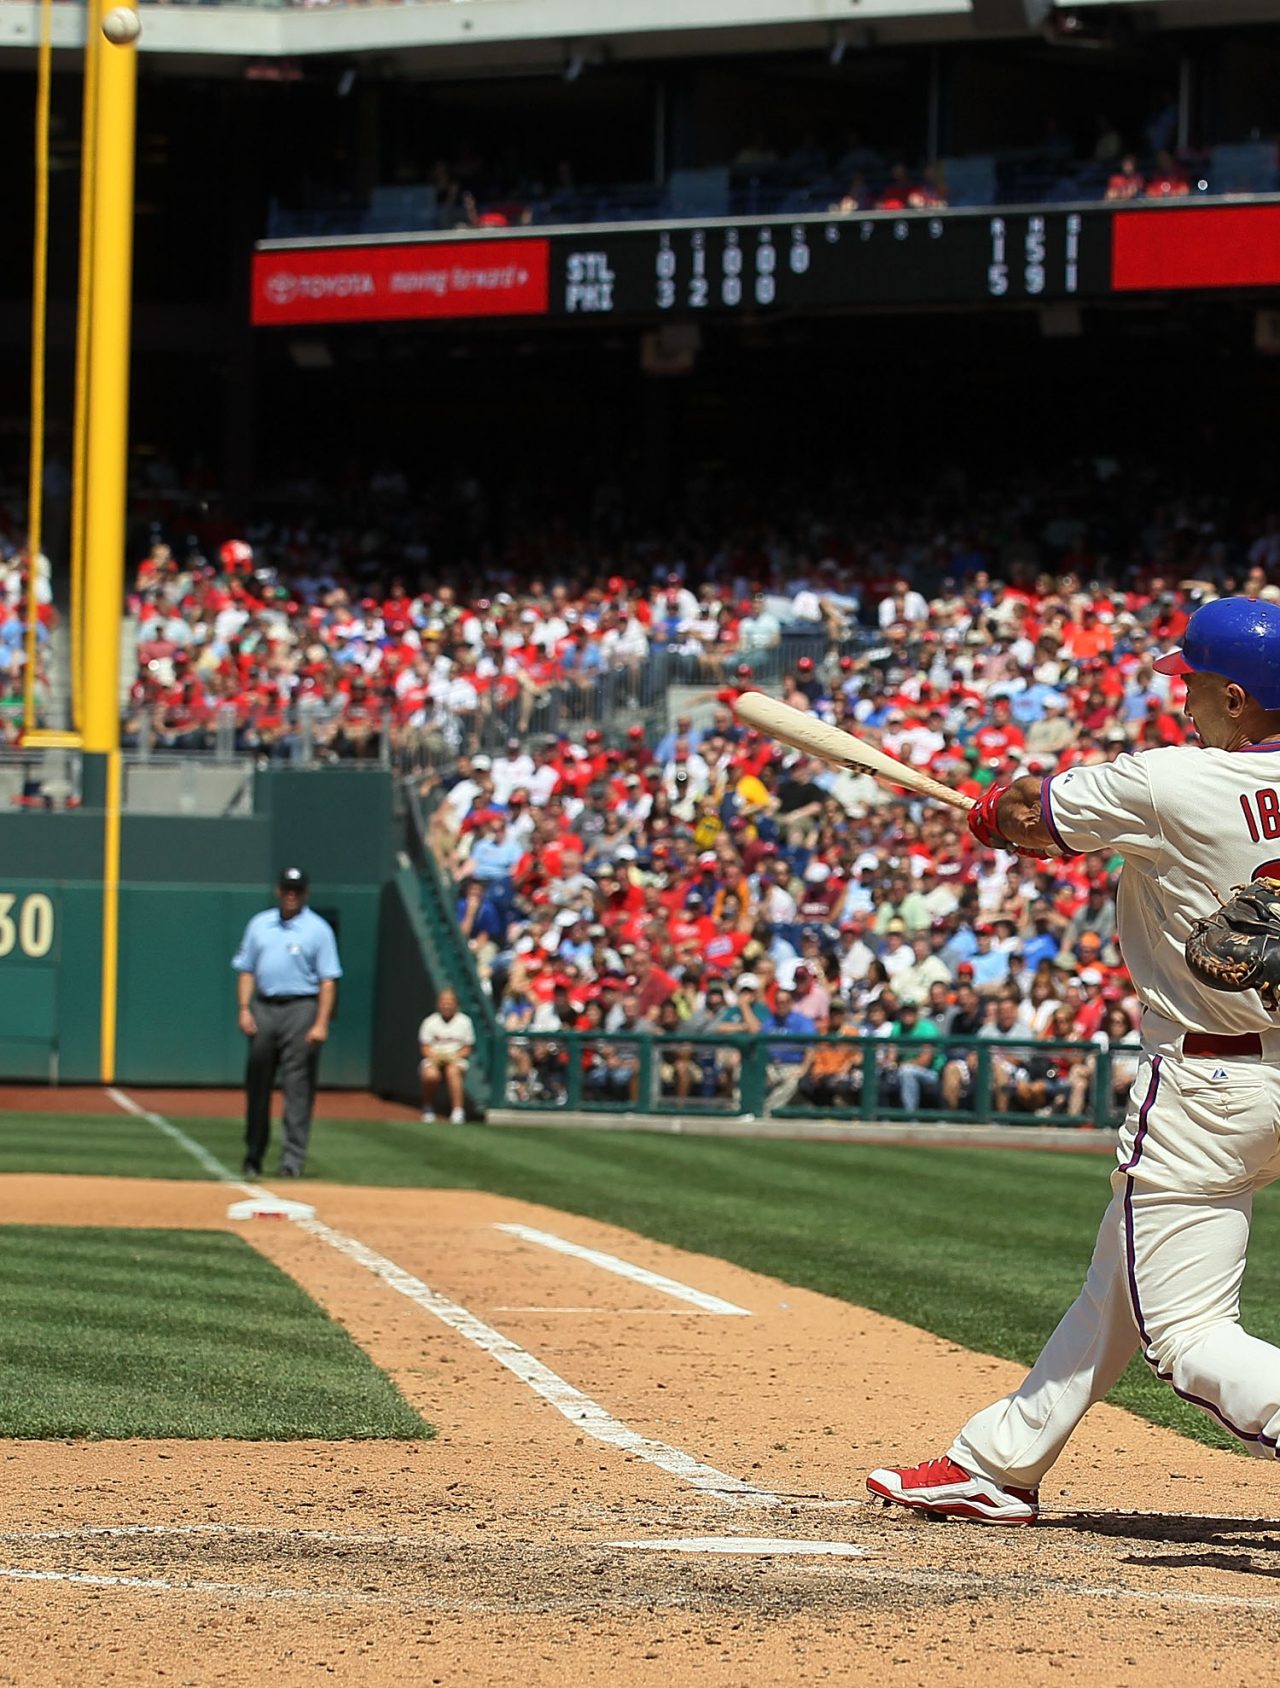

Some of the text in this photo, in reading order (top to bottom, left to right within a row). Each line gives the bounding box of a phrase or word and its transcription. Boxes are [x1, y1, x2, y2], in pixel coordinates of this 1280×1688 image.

[566, 233, 1079, 282] STL 0 1 0 0 0 1 5 1
[298, 272, 375, 298] TOYOTA
[656, 279, 676, 309] 3
[688, 277, 709, 308] 2
[721, 275, 743, 306] 0
[755, 274, 776, 305] 0
[988, 263, 1009, 296] 5
[1065, 262, 1078, 293] 1
